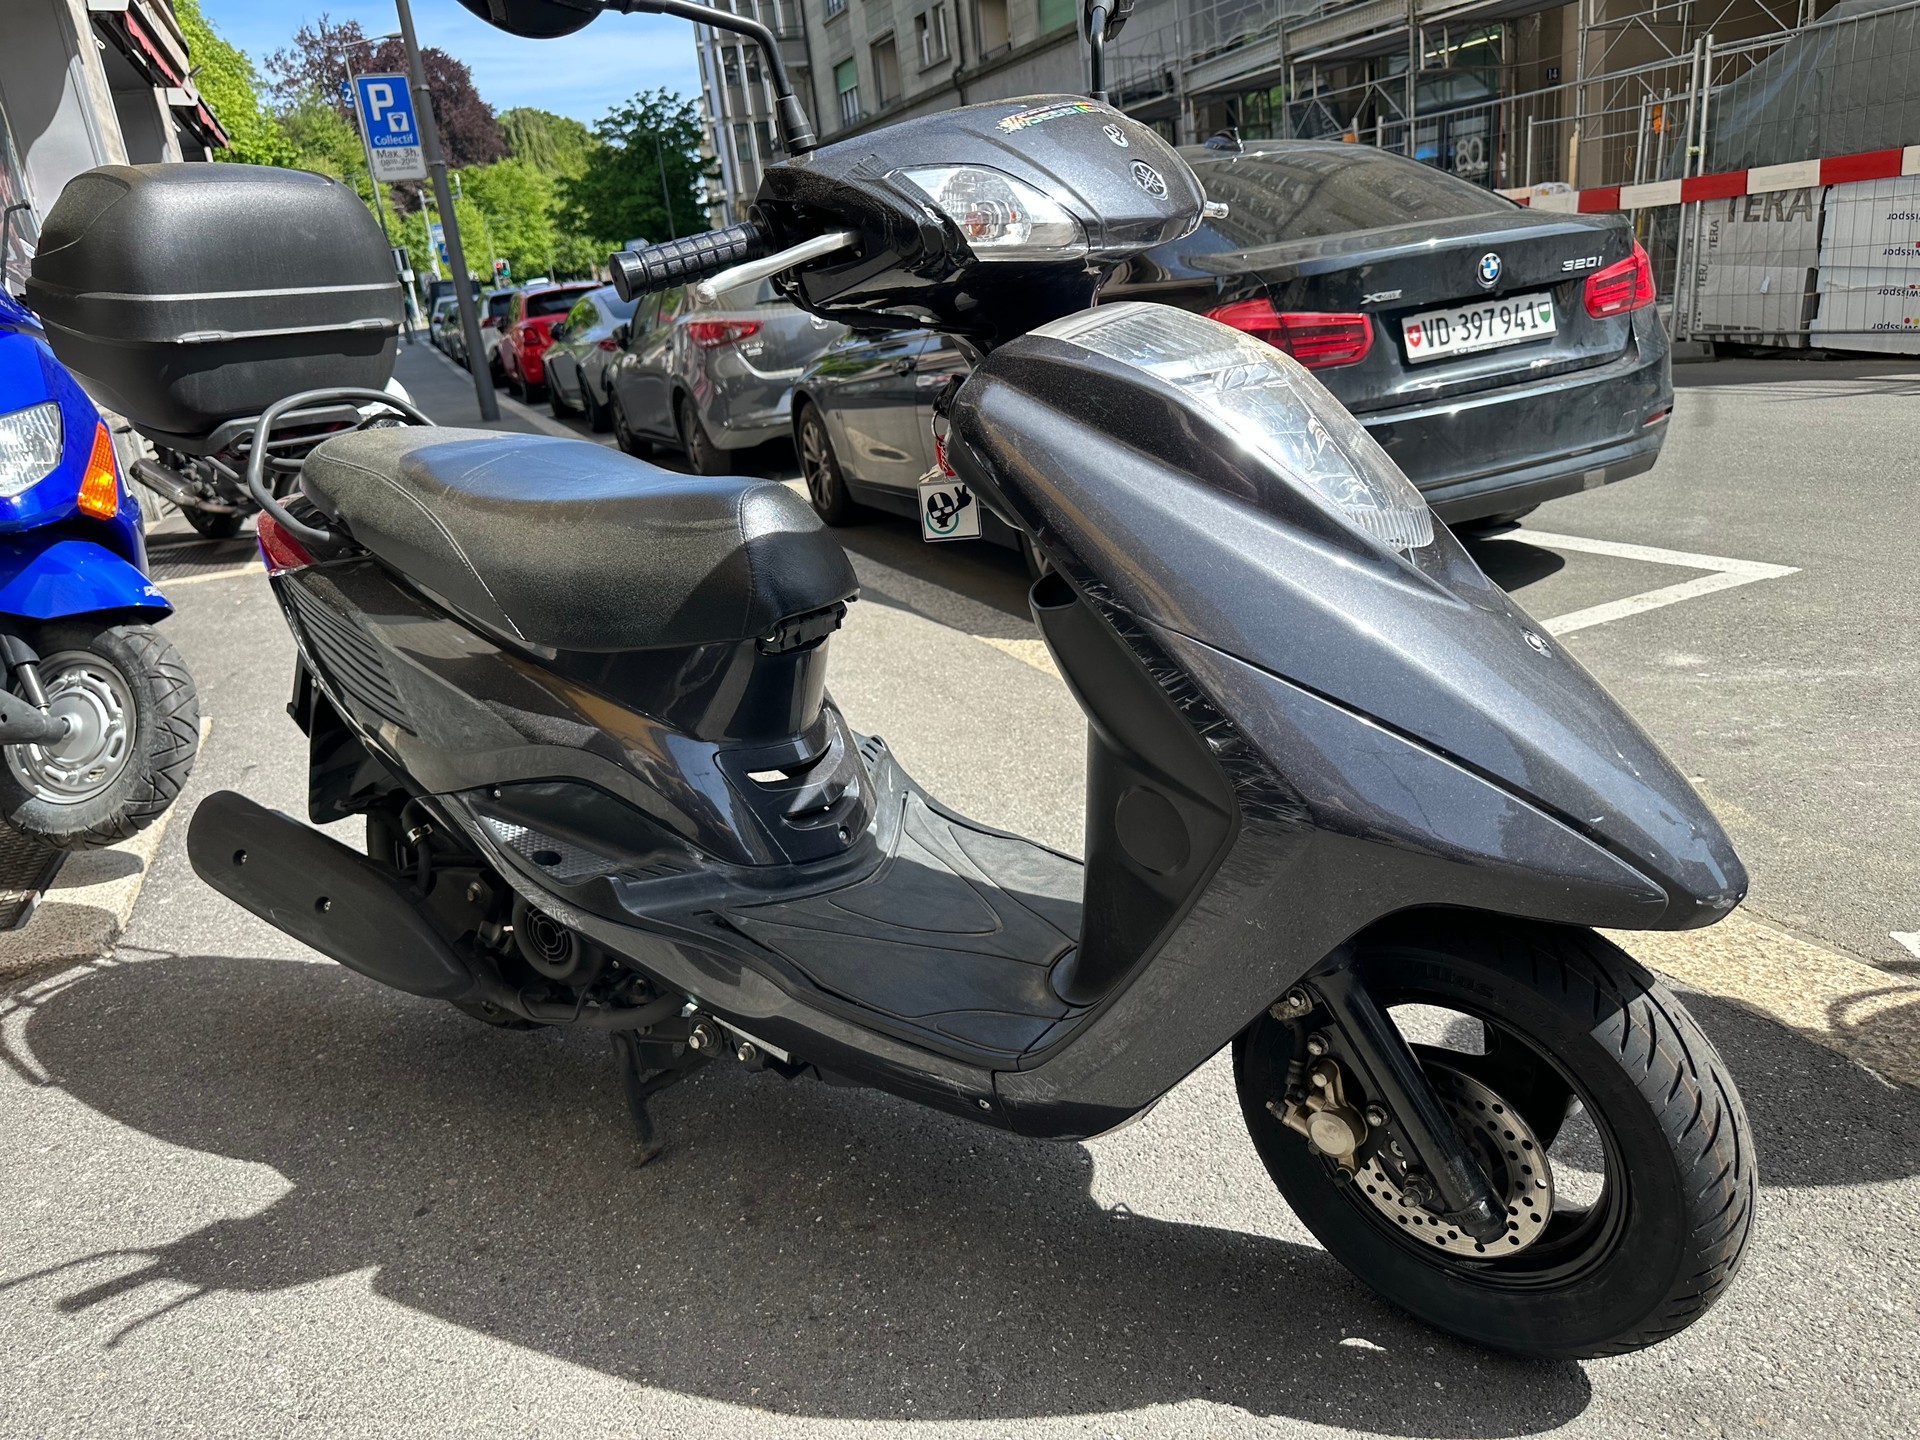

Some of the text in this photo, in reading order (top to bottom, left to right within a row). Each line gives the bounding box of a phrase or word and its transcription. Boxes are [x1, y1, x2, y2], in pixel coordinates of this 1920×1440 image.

[367, 84, 394, 121] P
[374, 133, 414, 146] Collectif
[377, 149, 402, 159] Max.
[1886, 210, 1920, 223] isspor
[1708, 219, 1720, 250] TERA
[1877, 287, 1920, 299] wisspor
[1500, 301, 1539, 335] 941
